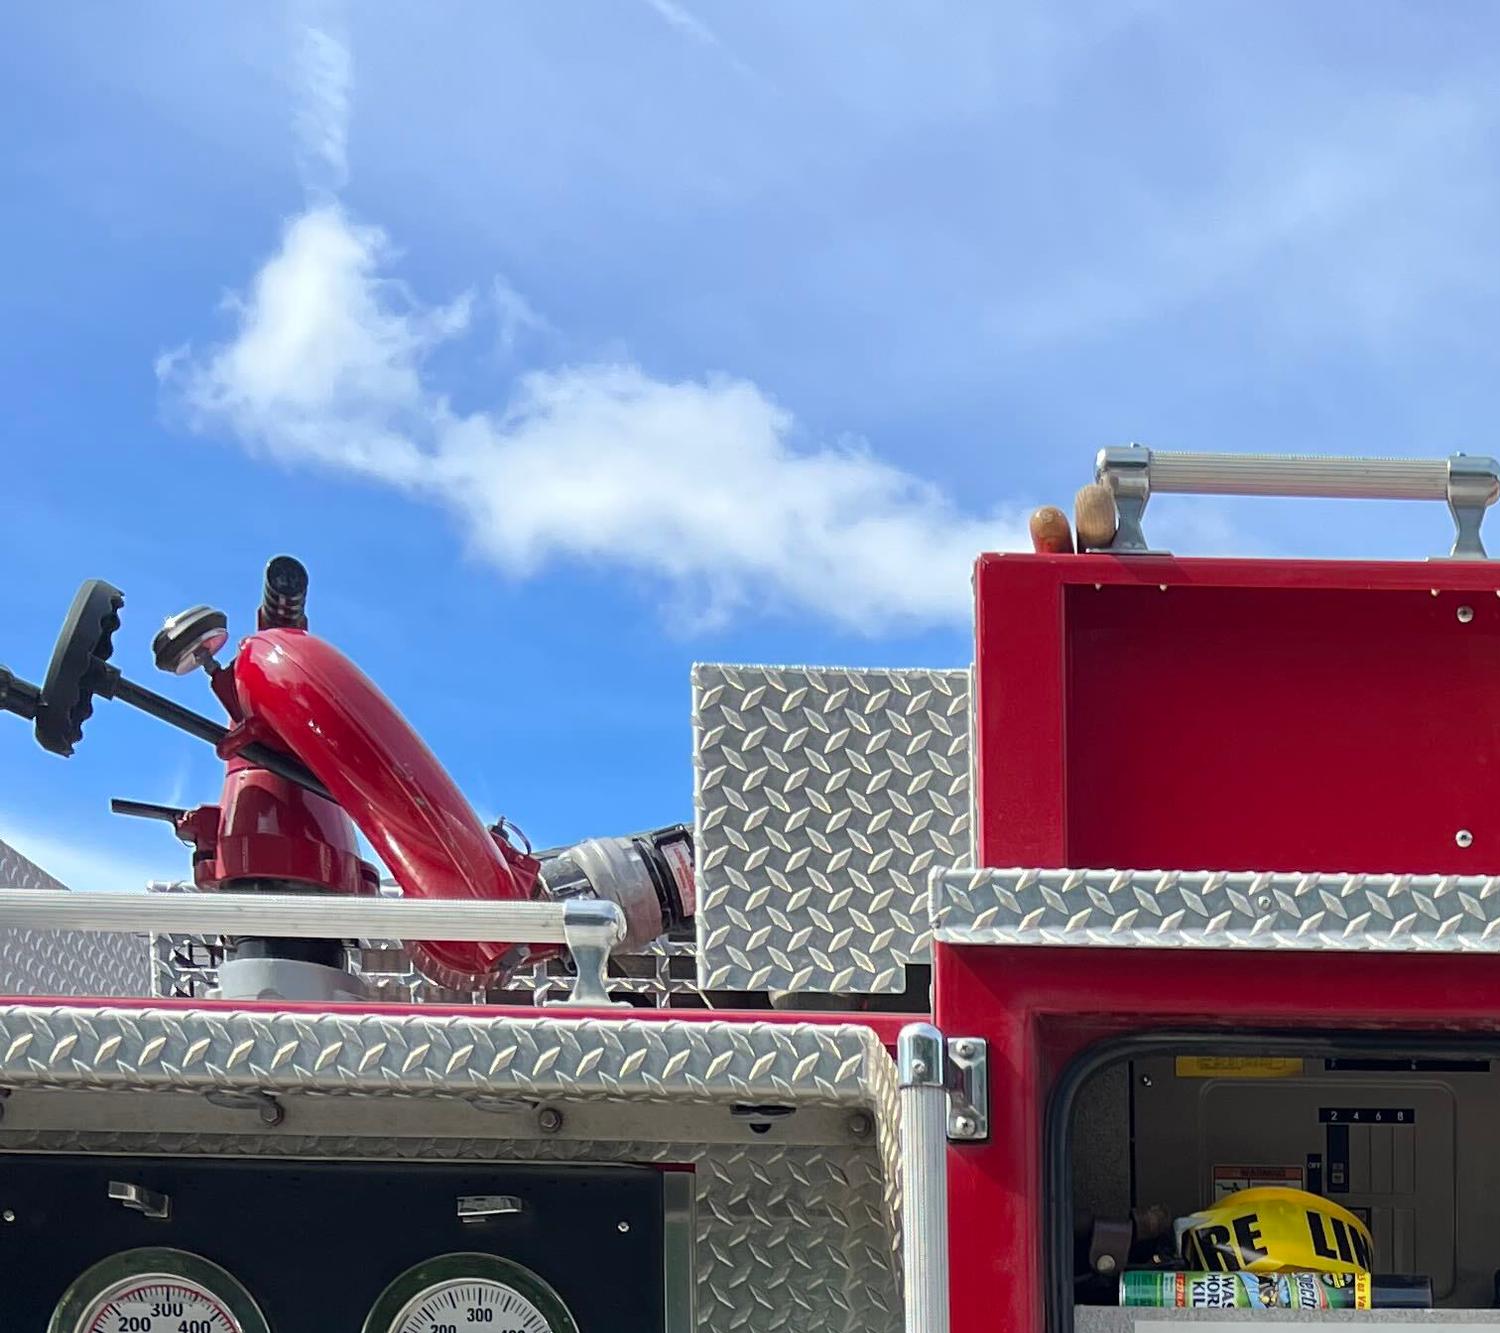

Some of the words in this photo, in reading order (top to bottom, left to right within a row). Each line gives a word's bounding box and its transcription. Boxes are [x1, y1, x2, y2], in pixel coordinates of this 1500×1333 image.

[1331, 1111, 1338, 1120] 2
[1353, 1111, 1359, 1120] 4
[1374, 1111, 1382, 1121] 6
[1397, 1112, 1404, 1121] 8
[150, 1303, 183, 1317] 300
[467, 1308, 493, 1322] 300
[119, 1317, 151, 1332] 200
